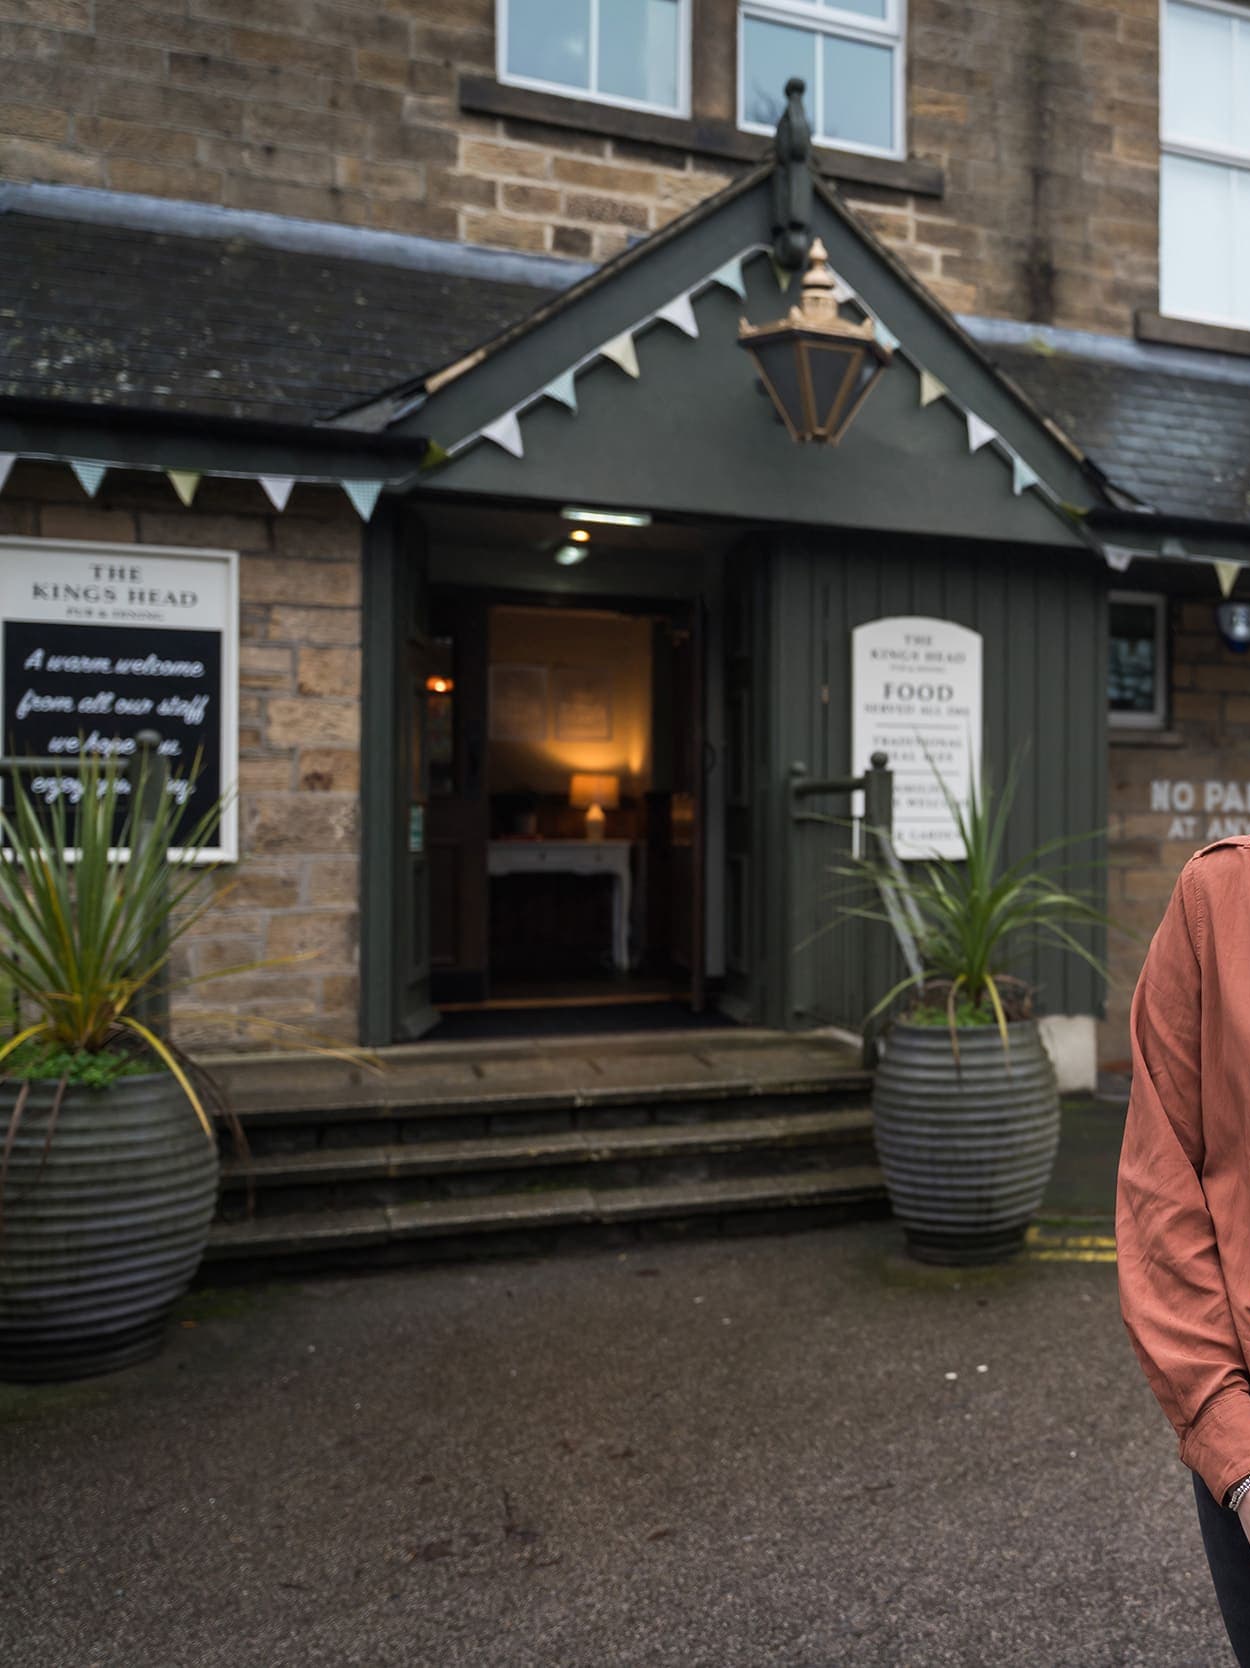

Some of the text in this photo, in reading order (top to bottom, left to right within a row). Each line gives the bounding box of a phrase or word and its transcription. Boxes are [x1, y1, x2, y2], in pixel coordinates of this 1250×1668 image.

[90, 563, 143, 583] THE
[32, 582, 199, 608] KINGS HEAD
[23, 648, 206, 678] A warm welcome
[883, 681, 954, 702] FOOD
[16, 687, 210, 725] from all our staff
[1151, 780, 1195, 811] NO
[1168, 817, 1196, 840] AT
